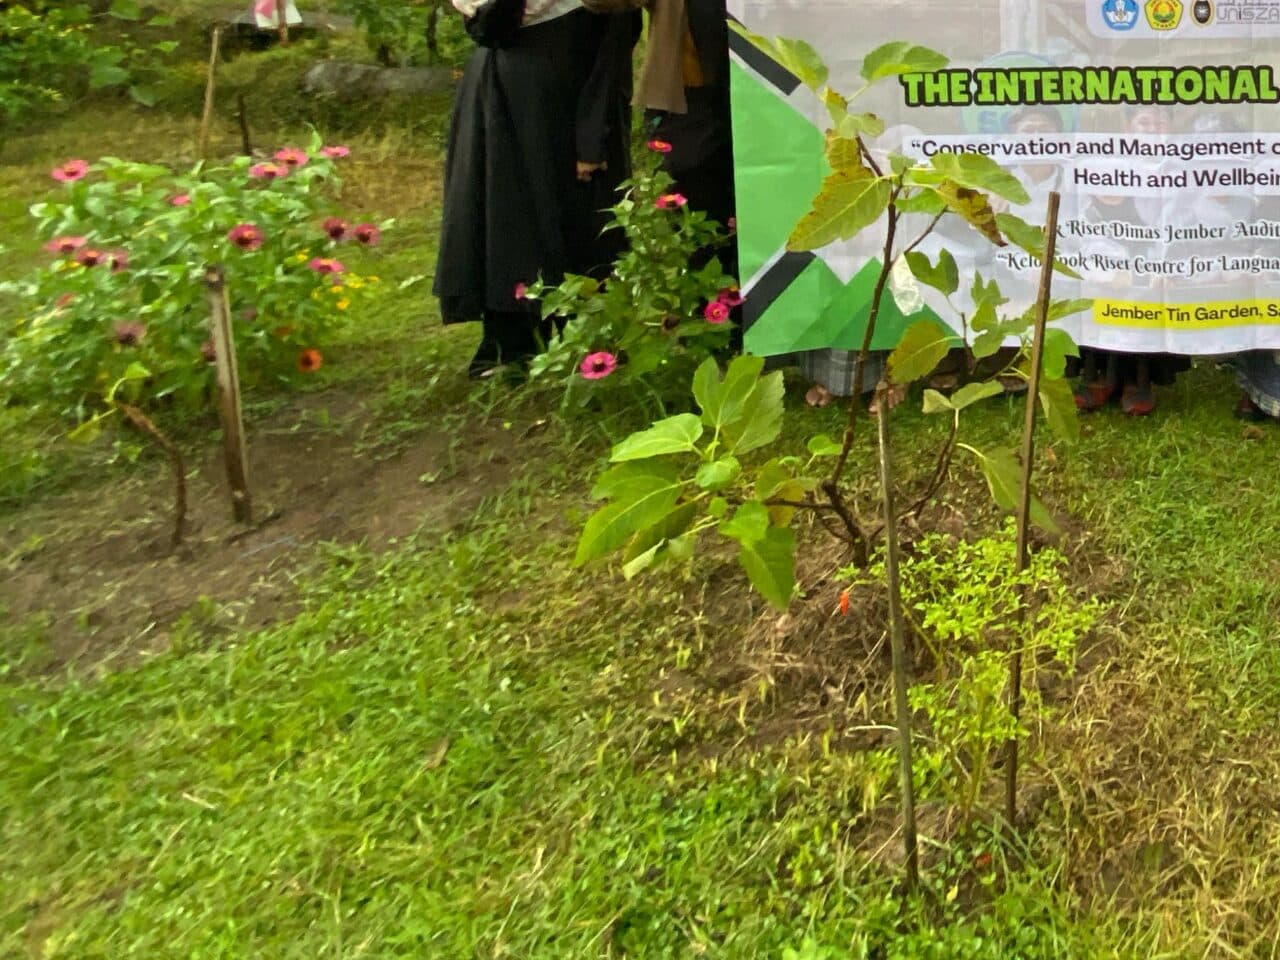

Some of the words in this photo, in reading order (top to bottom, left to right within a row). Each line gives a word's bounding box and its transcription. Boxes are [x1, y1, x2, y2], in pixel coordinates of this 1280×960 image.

[901, 69, 971, 105] THE
[974, 67, 1280, 105] INTERNATIONAL
[1075, 137, 1114, 155] and
[1119, 137, 1265, 160] Management
[1073, 168, 1141, 188] Health
[1147, 168, 1187, 188] and
[1067, 220, 1106, 238] Riset
[1109, 222, 1161, 240] Dimas
[1165, 223, 1226, 241] Jember
[1092, 254, 1131, 271] Riset
[1134, 256, 1185, 274] Centre
[1189, 255, 1213, 276] for
[1102, 303, 1162, 321] Jember
[1165, 306, 1190, 321] Tin
[1194, 305, 1263, 321] Garden,
